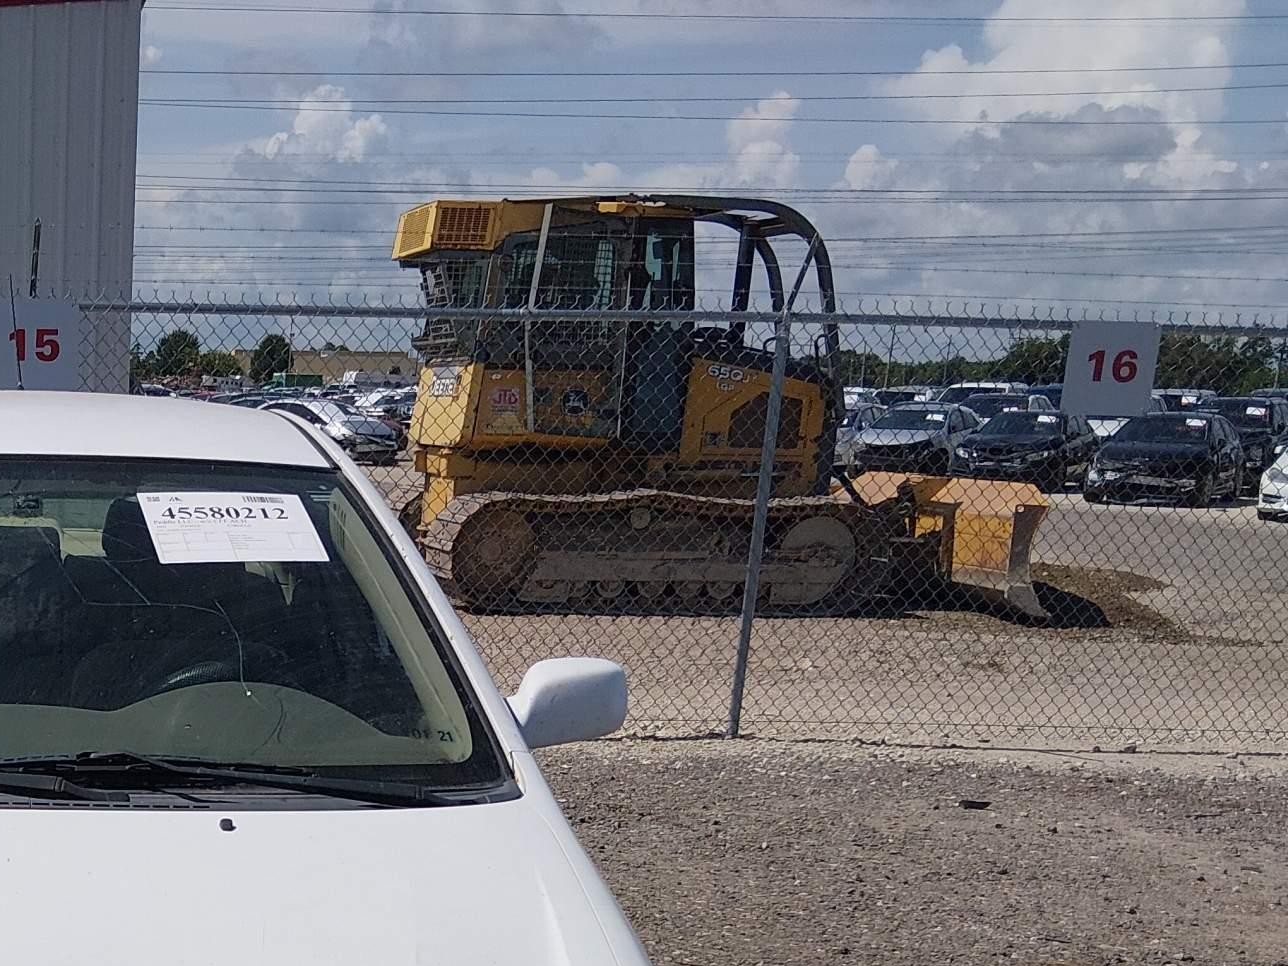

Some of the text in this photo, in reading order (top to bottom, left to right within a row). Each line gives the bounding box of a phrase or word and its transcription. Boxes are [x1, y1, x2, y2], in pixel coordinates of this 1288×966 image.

[9, 328, 60, 362] 15
[1087, 349, 1138, 383] 16
[161, 506, 289, 520] 45580212
[437, 730, 453, 742] 21
